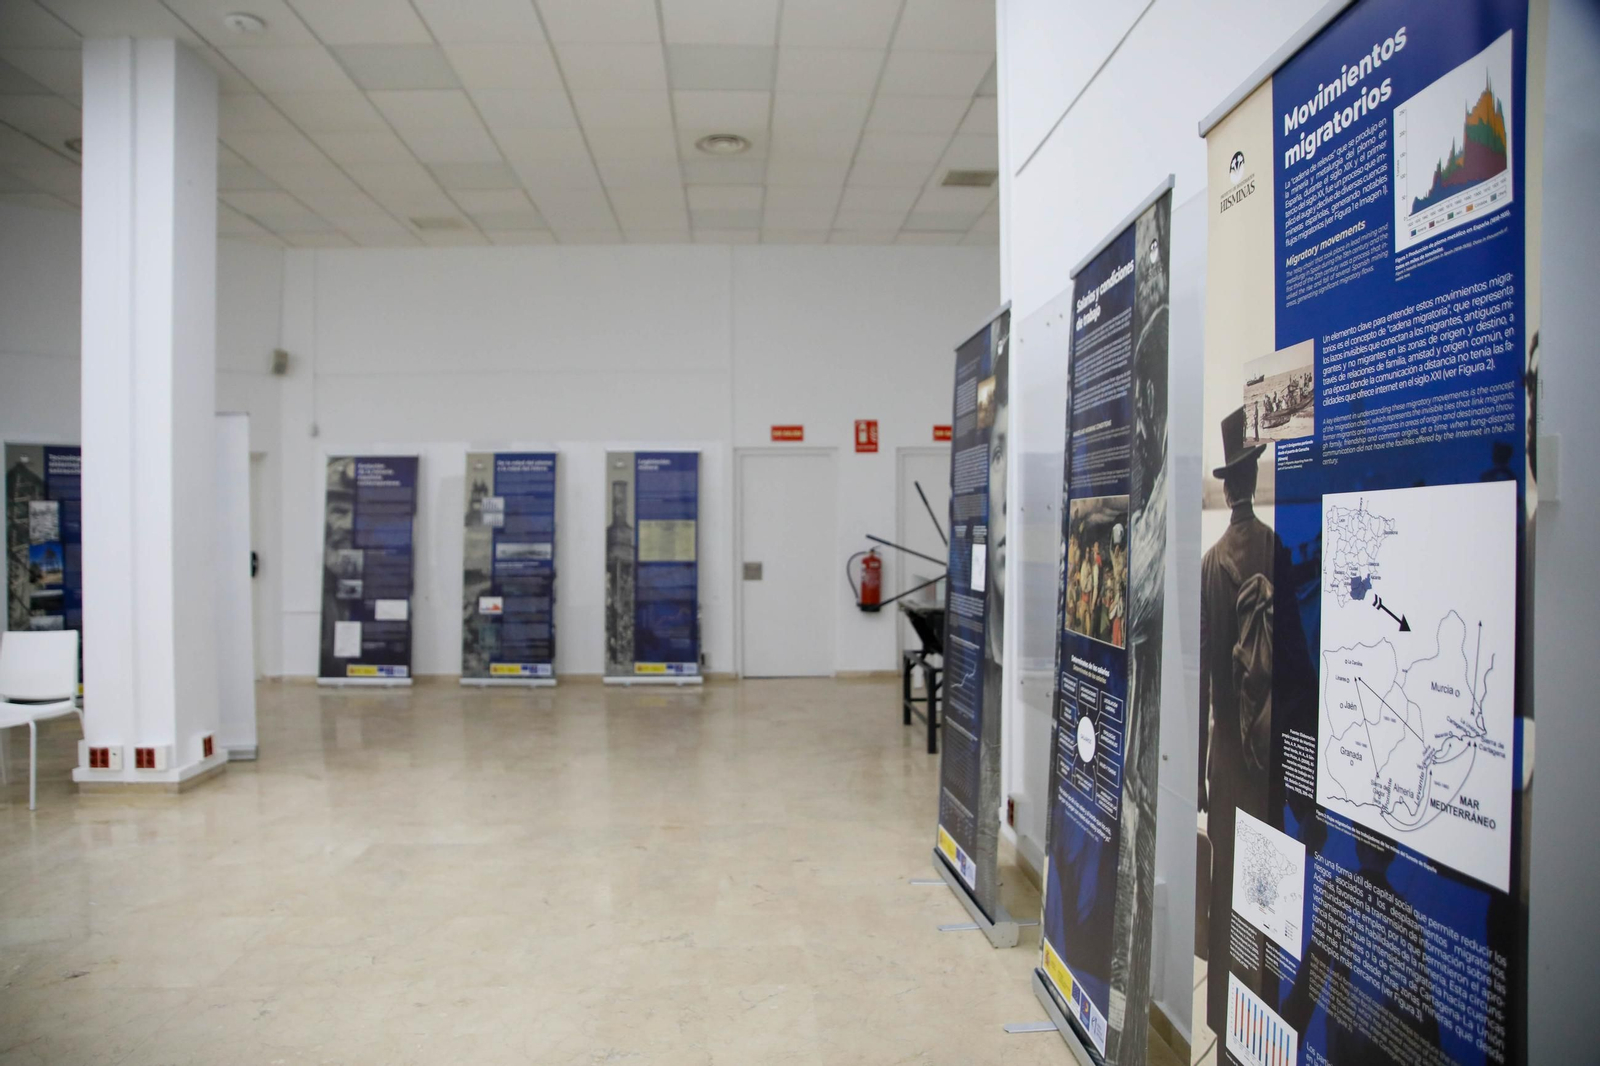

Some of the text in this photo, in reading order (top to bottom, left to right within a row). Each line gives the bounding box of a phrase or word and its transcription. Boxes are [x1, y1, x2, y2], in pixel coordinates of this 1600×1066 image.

[1284, 26, 1407, 136] Movimientos
[1284, 78, 1392, 169] migratorios
[1284, 180, 1290, 189] La
[1309, 163, 1316, 173] de
[1336, 143, 1347, 157] que
[1347, 138, 1354, 148] se
[1354, 123, 1377, 145] produjo
[1378, 116, 1387, 128] en
[1309, 175, 1314, 185] y
[1345, 146, 1354, 160] del
[1356, 135, 1376, 155] plomo
[1377, 128, 1387, 139] en
[1285, 219, 1365, 267] Migratory movements
[1076, 259, 1134, 314] Salarios y condiciones
[1322, 273, 1513, 343] Un elemento clave para entender estos movimientos migra-
[1076, 305, 1101, 331] de trabajo
[1322, 343, 1336, 354] torios
[1343, 337, 1349, 347] el
[1349, 329, 1377, 345] concepto
[1377, 326, 1386, 336] de
[1452, 300, 1469, 314] que
[1471, 284, 1513, 306] representa
[1322, 363, 1341, 376] grantes
[1342, 362, 1346, 370] y
[1347, 359, 1356, 367] no
[1356, 350, 1386, 364] migrantes
[1387, 348, 1396, 356] en
[1397, 344, 1406, 353] las
[1407, 339, 1426, 350] zonas
[1427, 334, 1437, 344] de
[1439, 327, 1465, 341] origen
[1467, 325, 1473, 336] y
[1509, 313, 1514, 322] a
[1329, 353, 1342, 362] lazos
[1342, 344, 1367, 358] invisibles
[1368, 341, 1380, 352] que
[1380, 332, 1408, 347] conectan
[1414, 327, 1423, 336] los
[1424, 316, 1462, 333] migrantes,
[1463, 303, 1500, 321] antiguos
[1501, 297, 1513, 310] mi-
[1322, 327, 1514, 385] través de relaciones de familia, amistad y origen común, en
[1332, 383, 1349, 394] época
[1349, 377, 1368, 389] donde
[1369, 375, 1374, 384] la
[1375, 364, 1417, 382] comunicación
[1418, 364, 1422, 372] a
[1423, 354, 1456, 370] distancia
[1457, 353, 1468, 362] no
[1470, 345, 1491, 359] tenía
[1492, 343, 1504, 354] las
[1504, 340, 1513, 351] fa-
[1344, 392, 1356, 402] que
[1374, 380, 1398, 394] internet
[1398, 380, 1407, 388] en
[1407, 376, 1413, 386] el
[1413, 373, 1429, 386] siglo
[1442, 368, 1456, 380] (ver
[1458, 362, 1484, 375] Figura
[1485, 357, 1495, 369] 2).
[1345, 701, 1357, 711] Jaén
[1431, 681, 1453, 695] Murcia
[1340, 746, 1362, 761] Granada
[1479, 744, 1506, 758] Cartagena
[1393, 783, 1414, 799] Almería
[1414, 772, 1424, 807] Levante
[1430, 798, 1496, 830] MEDITERRÁNEO
[1460, 795, 1480, 810] MAR
[1313, 850, 1324, 864] Son
[1324, 858, 1334, 869] una
[1335, 862, 1352, 880] forma
[1363, 878, 1371, 891] de
[1372, 885, 1394, 903] capital
[1394, 897, 1412, 914] social
[1413, 908, 1427, 922] que
[1427, 916, 1458, 940] permite
[1460, 934, 1493, 959] reducir
[1494, 950, 1507, 967] los
